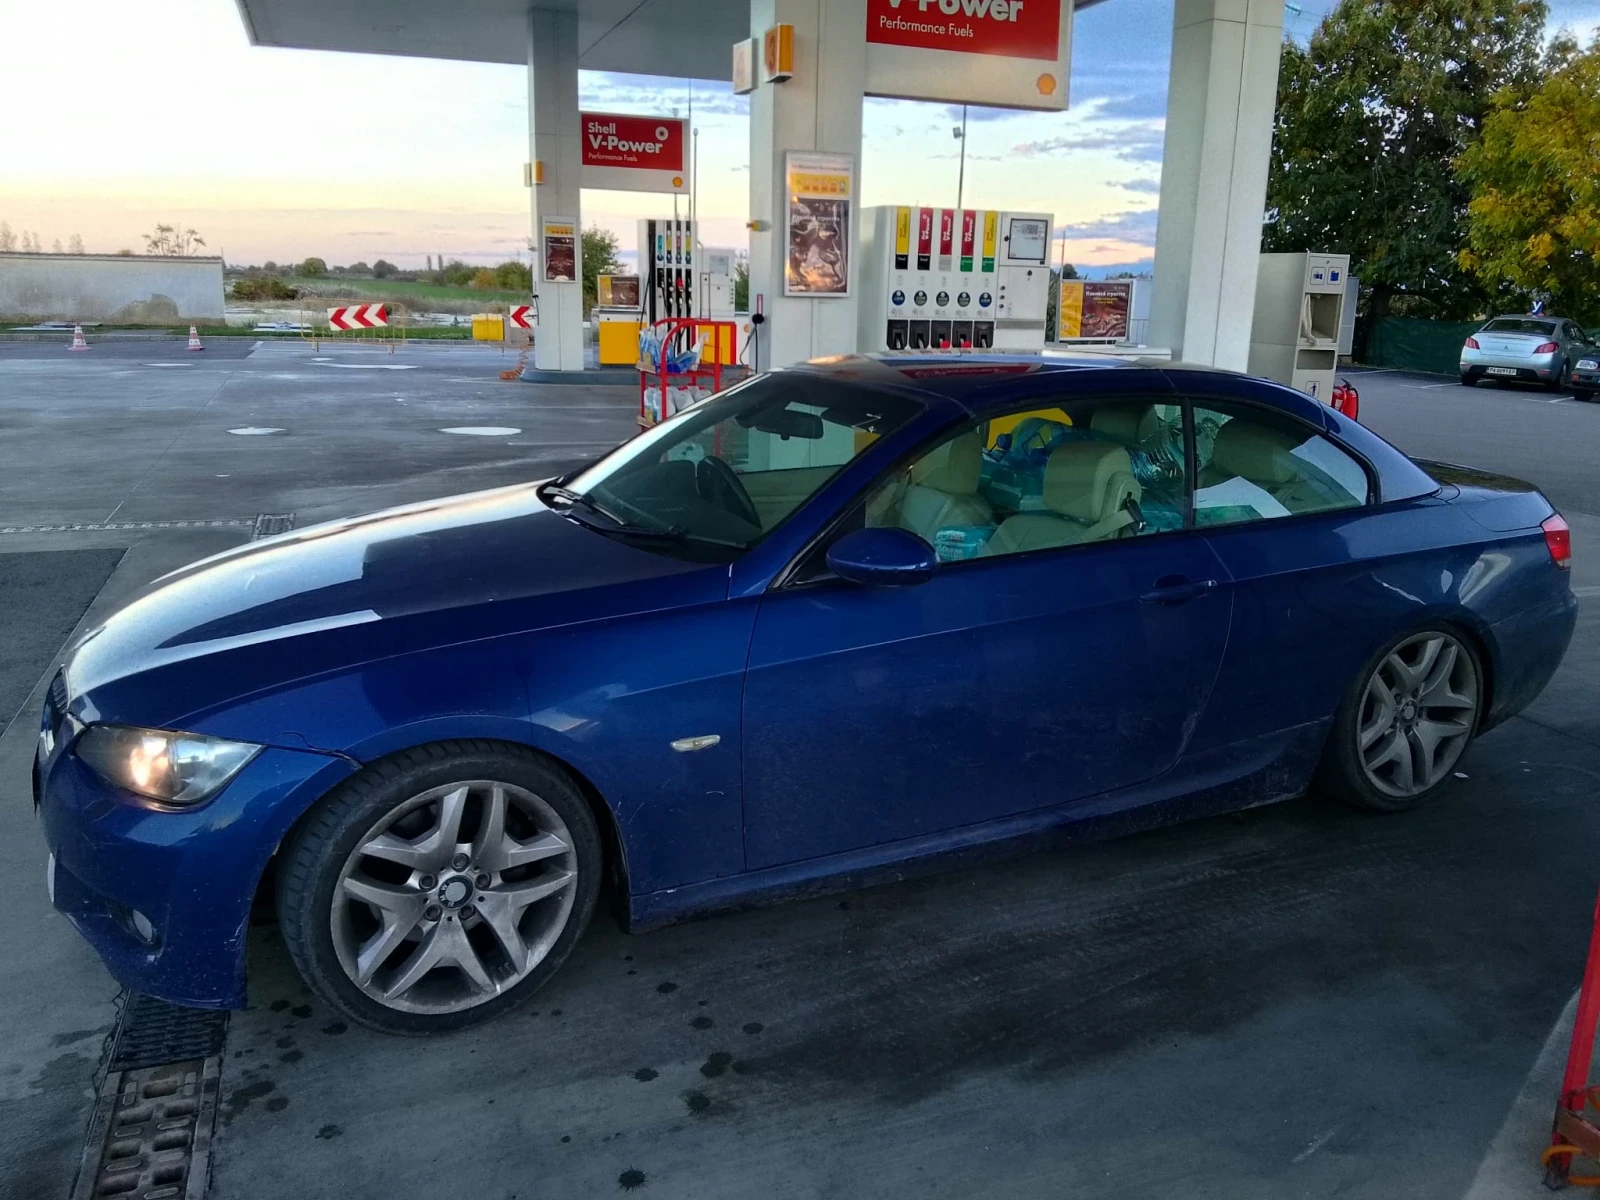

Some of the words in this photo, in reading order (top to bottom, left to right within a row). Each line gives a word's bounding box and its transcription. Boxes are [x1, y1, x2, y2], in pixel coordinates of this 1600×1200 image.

[880, 15, 946, 35] Performance
[948, 23, 974, 38] Fuels
[588, 121, 616, 134] Shell
[588, 134, 663, 154] V-Power
[588, 152, 623, 161] Performance
[623, 154, 638, 162] Fuels
